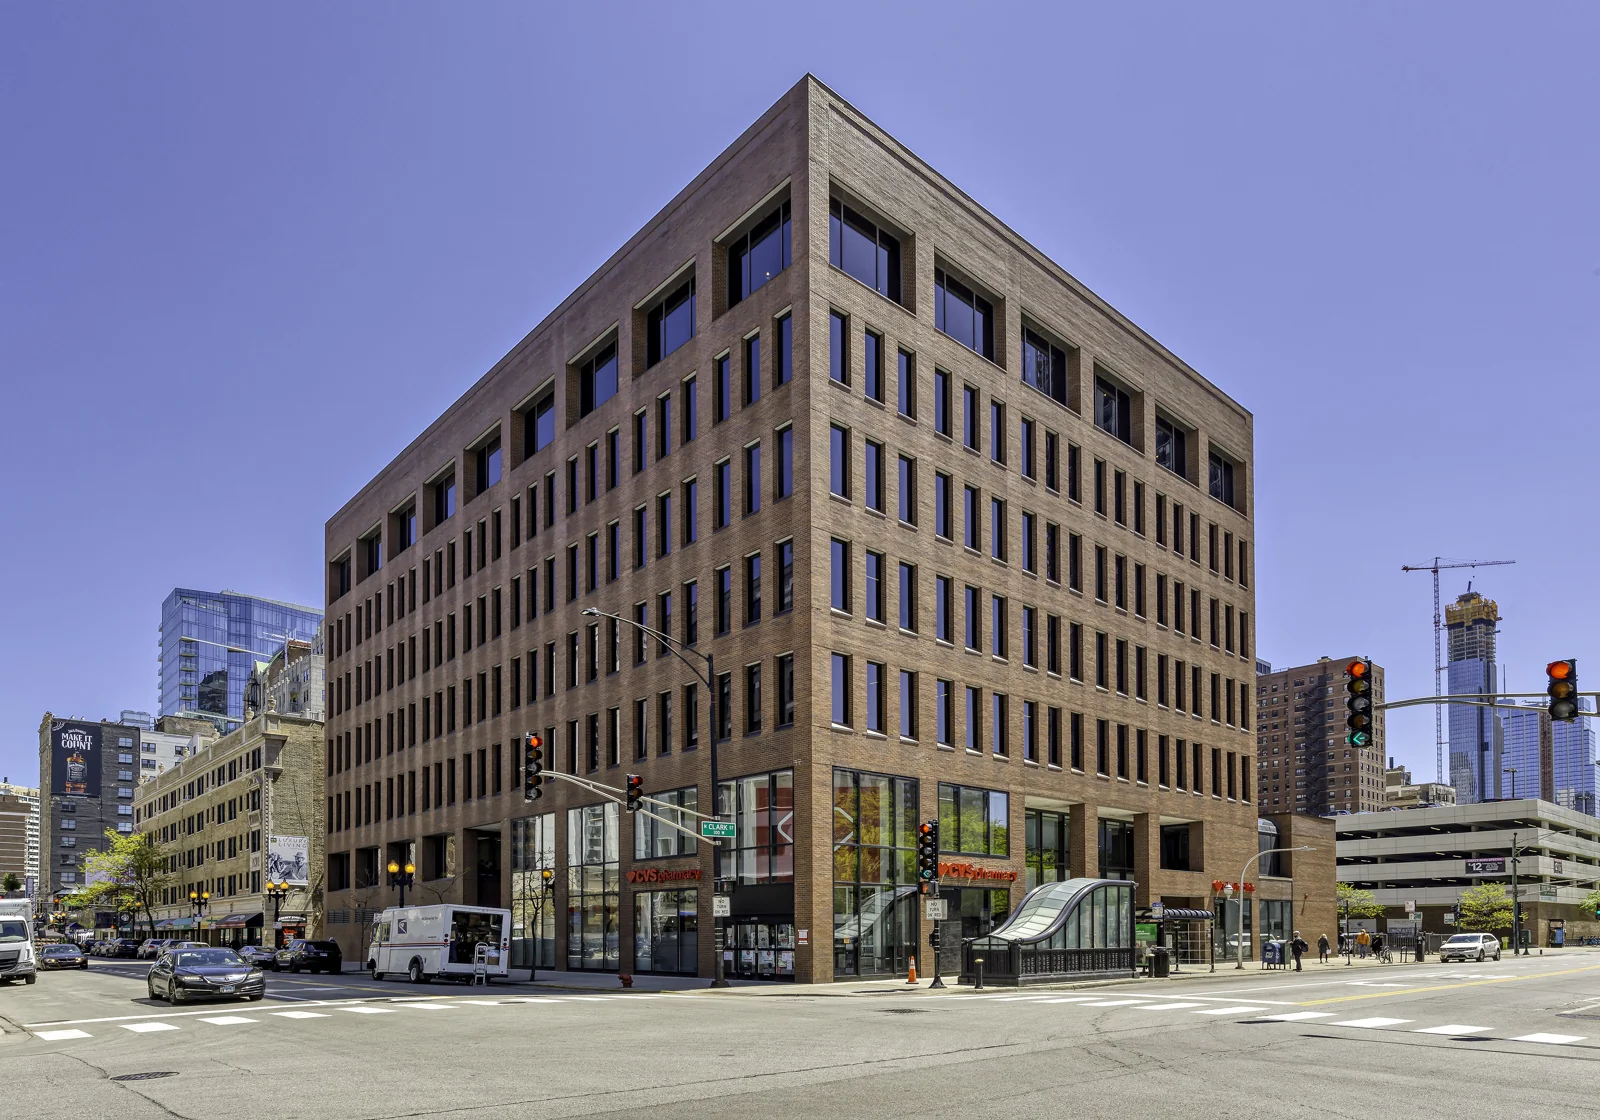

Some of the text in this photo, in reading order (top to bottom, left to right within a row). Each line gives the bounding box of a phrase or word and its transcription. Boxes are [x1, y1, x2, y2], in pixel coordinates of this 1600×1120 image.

[61, 733, 83, 741] MAKE
[61, 739, 93, 751] COUNT
[708, 823, 728, 831] CLARK
[636, 869, 702, 884] CVS pharmacy
[948, 863, 1018, 882] CVS pharmacy
